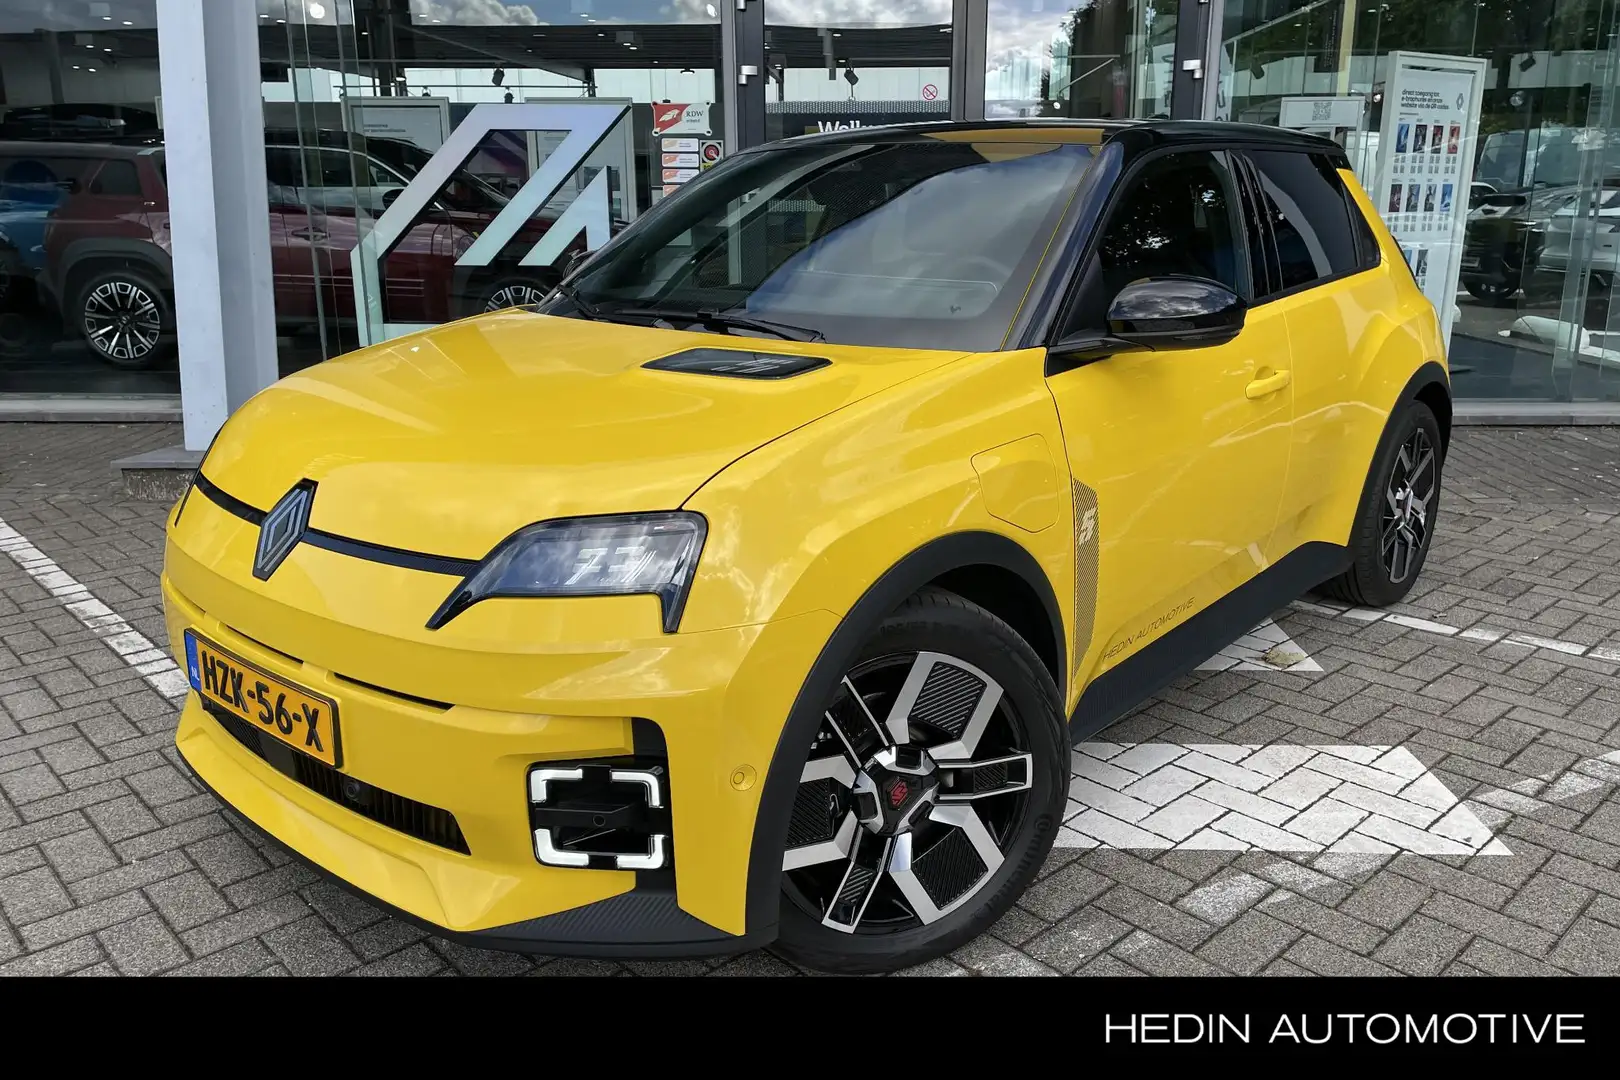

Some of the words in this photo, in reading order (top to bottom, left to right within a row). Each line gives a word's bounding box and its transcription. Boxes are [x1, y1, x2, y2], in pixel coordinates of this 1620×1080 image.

[1103, 635, 1135, 660] HEDIN
[1137, 596, 1195, 639] AUTOMOTIVE
[191, 665, 200, 681] NL
[202, 650, 324, 752] HZK-56-X
